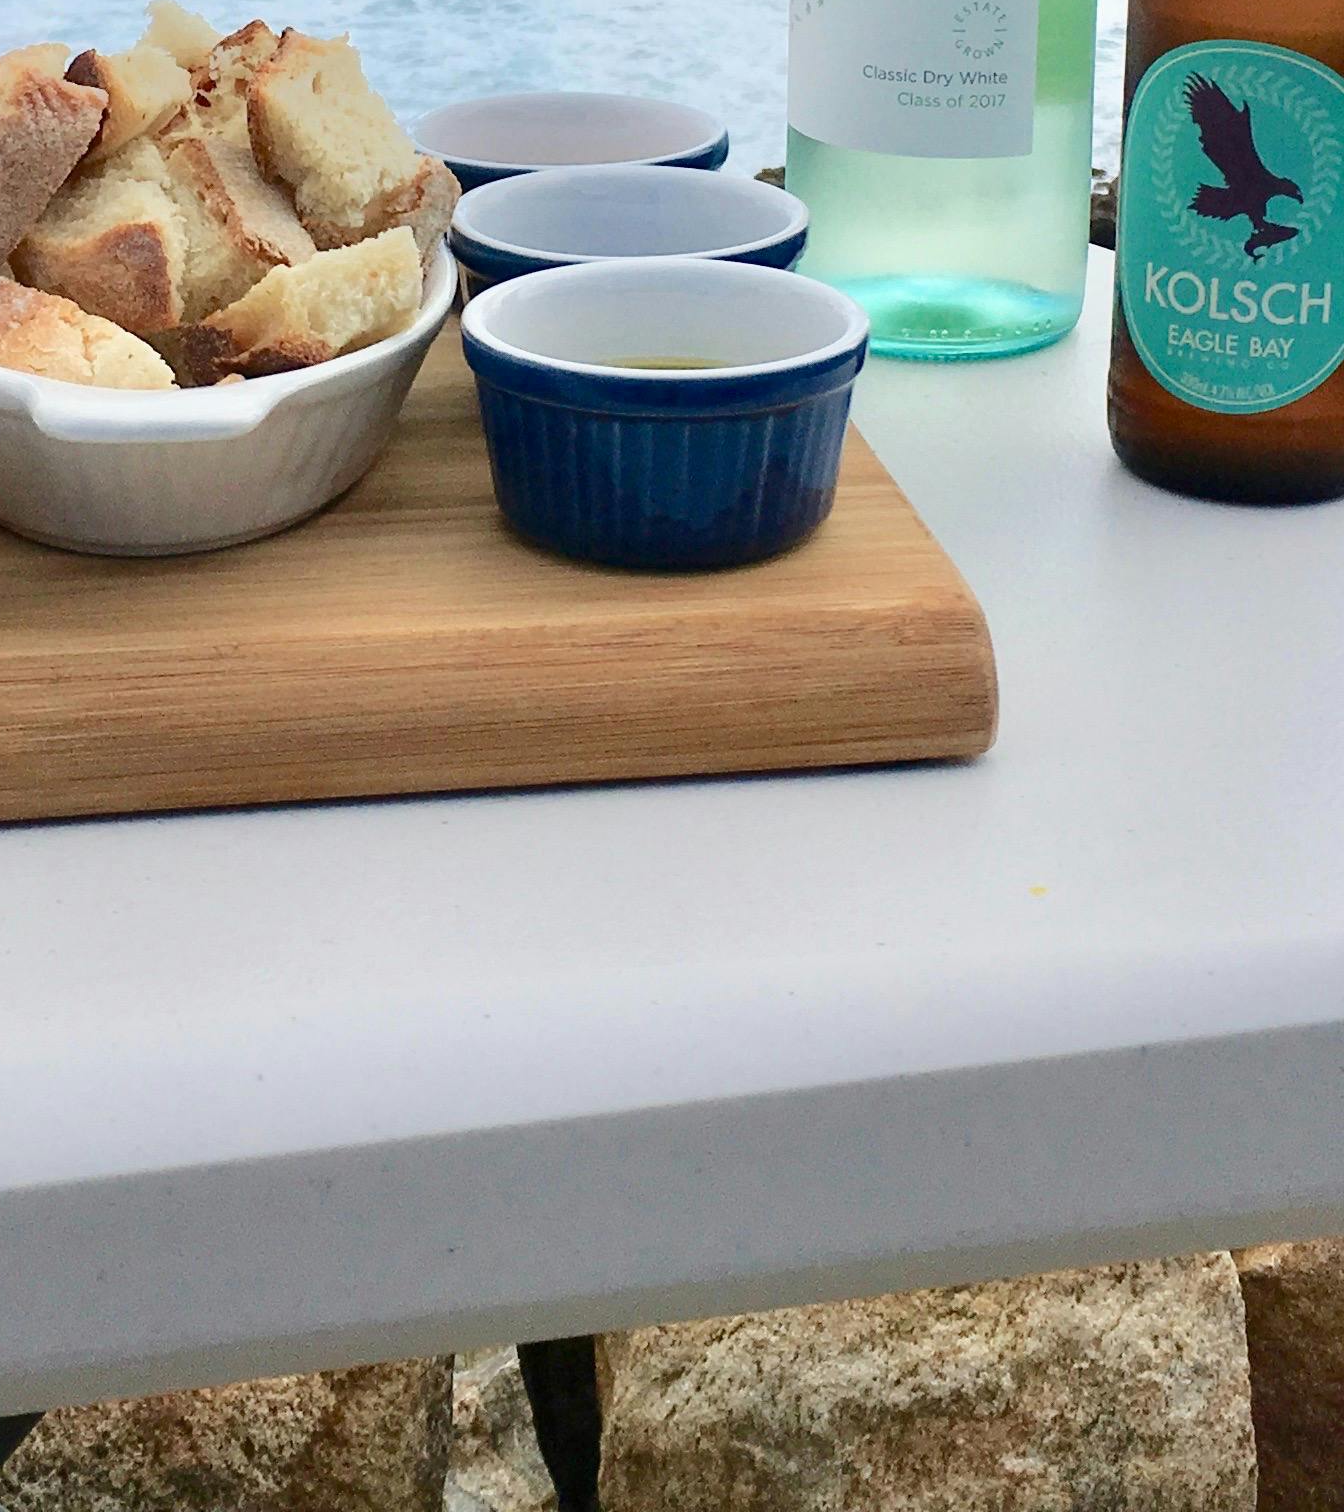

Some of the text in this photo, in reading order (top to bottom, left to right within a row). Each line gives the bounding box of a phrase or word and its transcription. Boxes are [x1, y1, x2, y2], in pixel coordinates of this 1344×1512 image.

[953, 1, 1007, 24] ESTATE
[954, 39, 1005, 59] GROWN
[862, 64, 1008, 87] Classic Dry White
[897, 91, 1006, 108] Class of 2017
[1144, 262, 1332, 324] KOLSCH
[1168, 324, 1295, 359] EAGLE BAY
